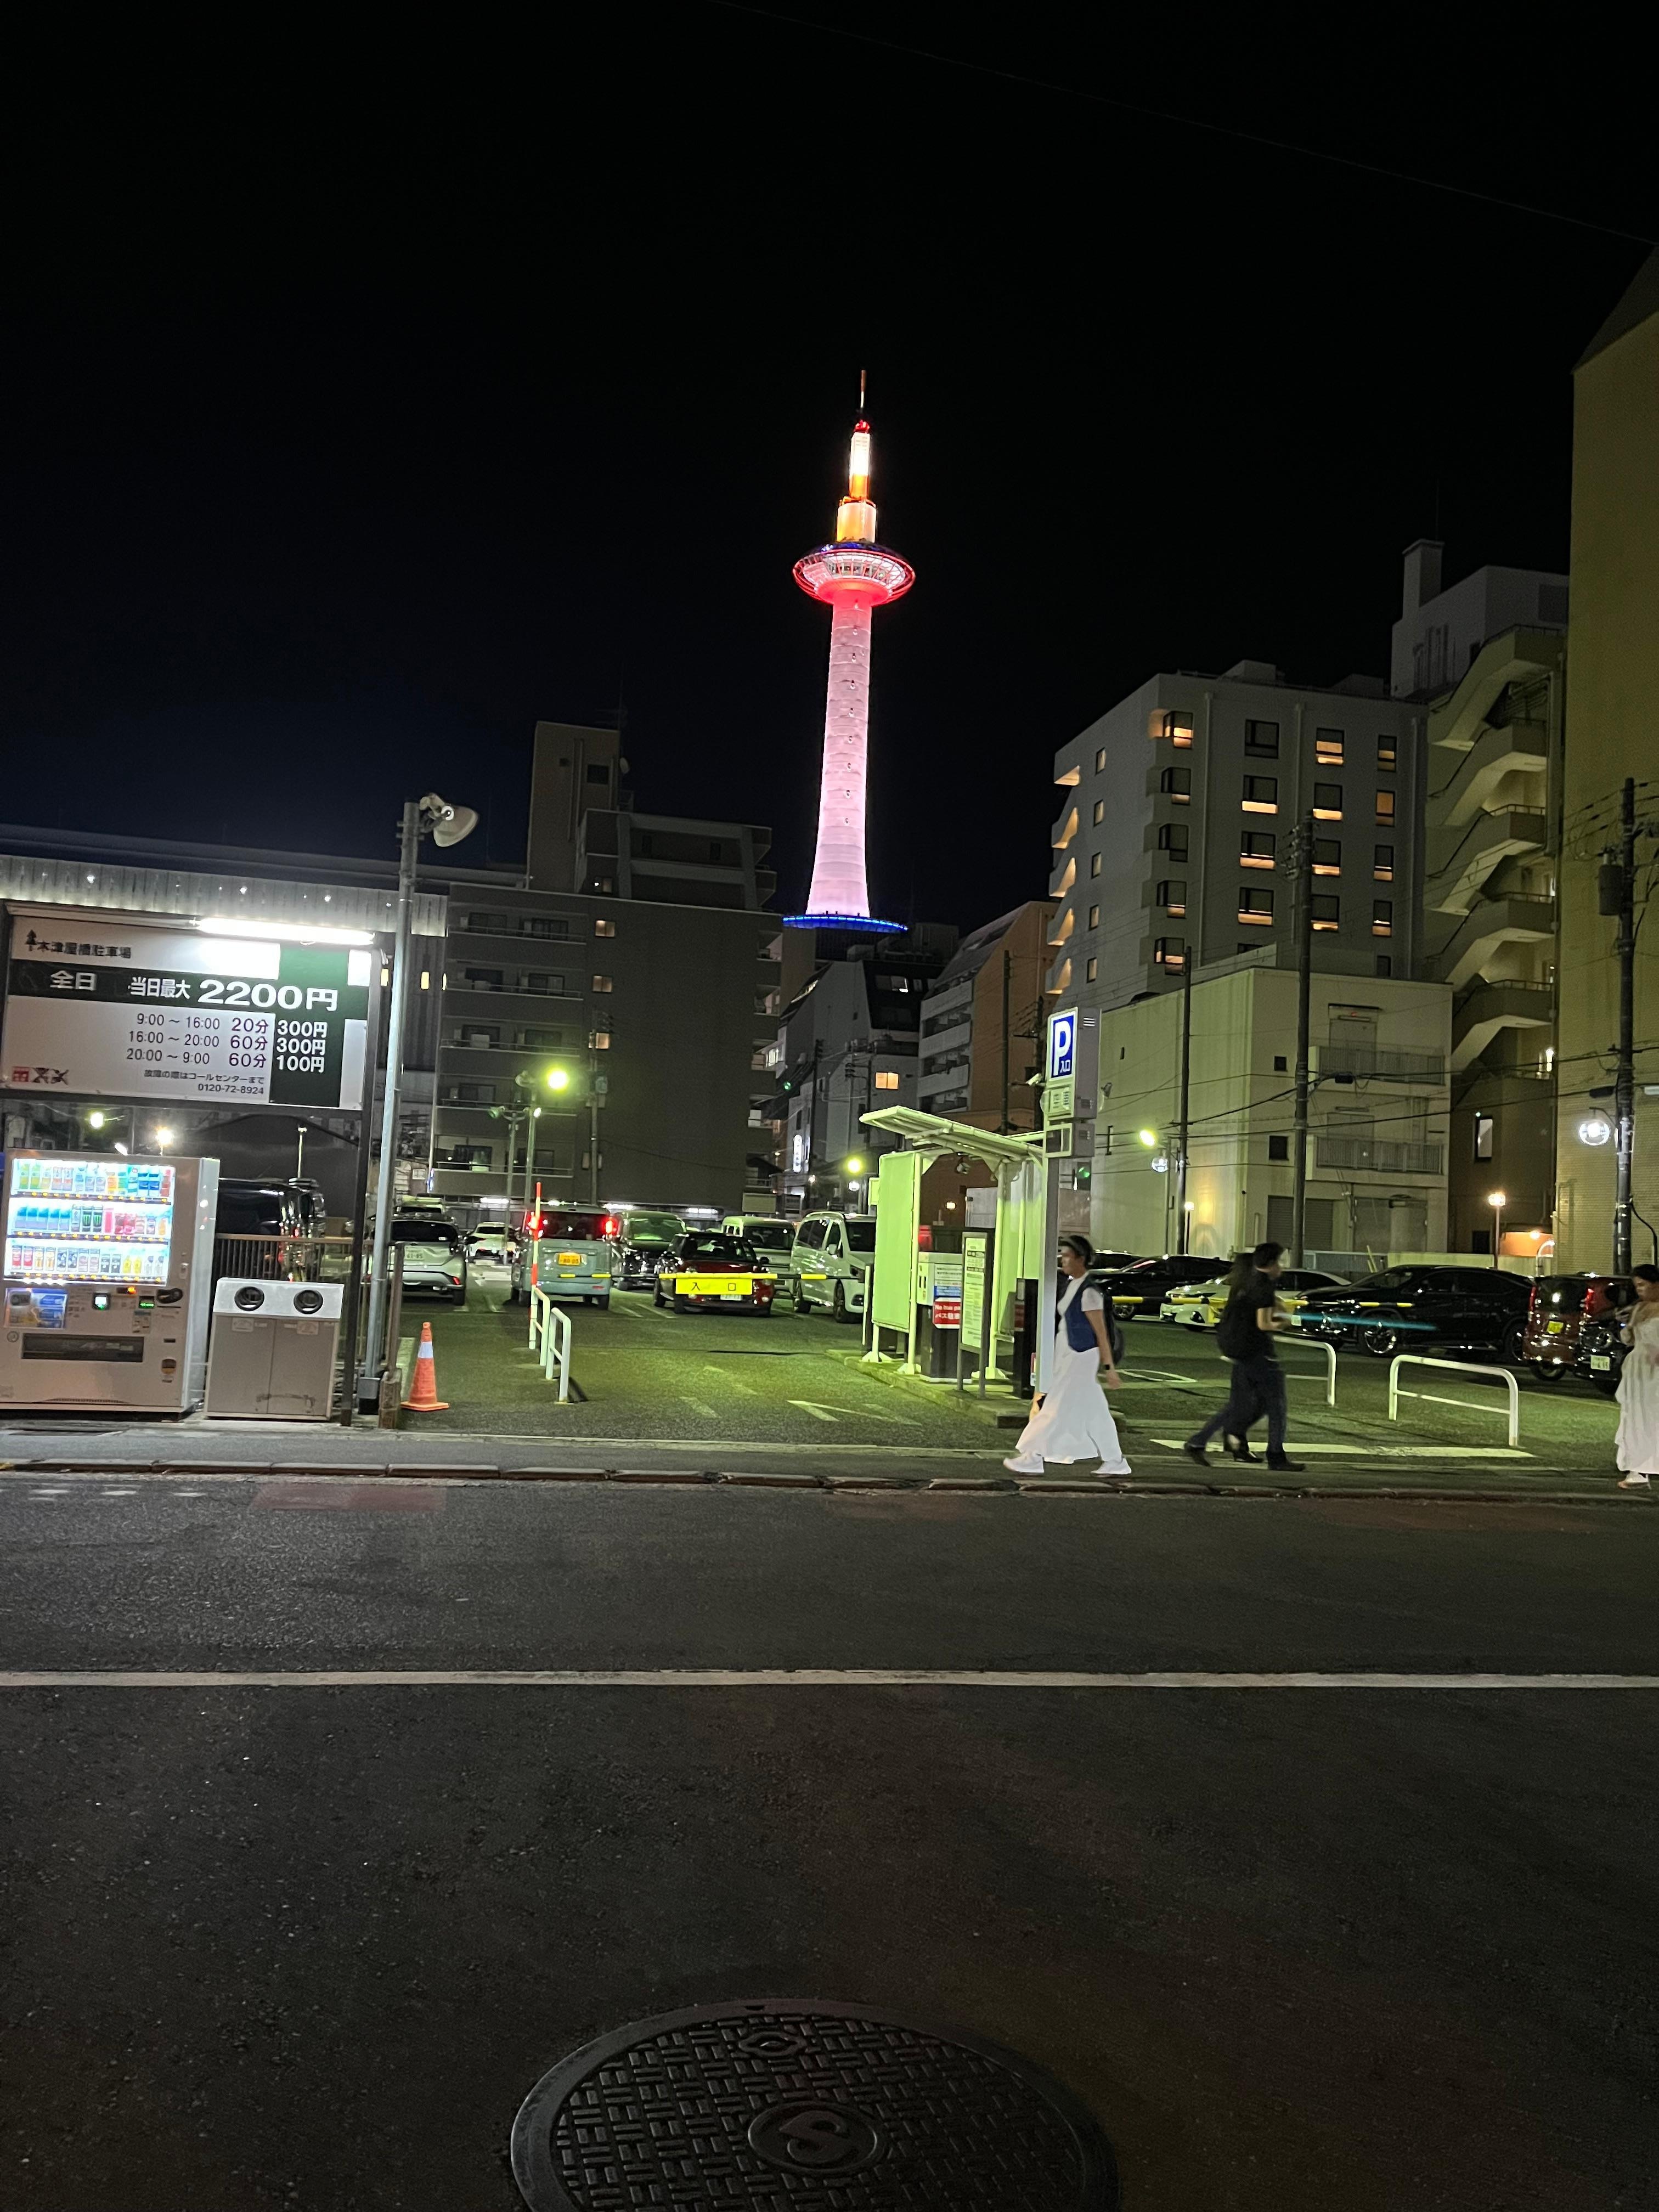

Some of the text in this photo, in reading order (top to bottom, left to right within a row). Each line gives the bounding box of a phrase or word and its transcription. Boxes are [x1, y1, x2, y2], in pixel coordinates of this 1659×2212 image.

[50, 970, 338, 1012] 全日 当日最大 2200円
[137, 1013, 165, 1026] 9:00
[186, 1016, 220, 1030] 16:00
[232, 1017, 269, 1034] 20分
[277, 1019, 328, 1038] 300円
[129, 1030, 164, 1043] 16:00
[184, 1034, 219, 1047] 20:00
[230, 1035, 268, 1051] 60分
[276, 1037, 326, 1056] 300円
[1053, 1020, 1071, 1076] P
[126, 1048, 162, 1062] 20:00
[183, 1051, 210, 1064] 9:00
[229, 1052, 267, 1068] 60分
[276, 1054, 325, 1073] 100円
[1060, 1060, 1070, 1073] 入口
[198, 1083, 264, 1094] 0120-72-8924
